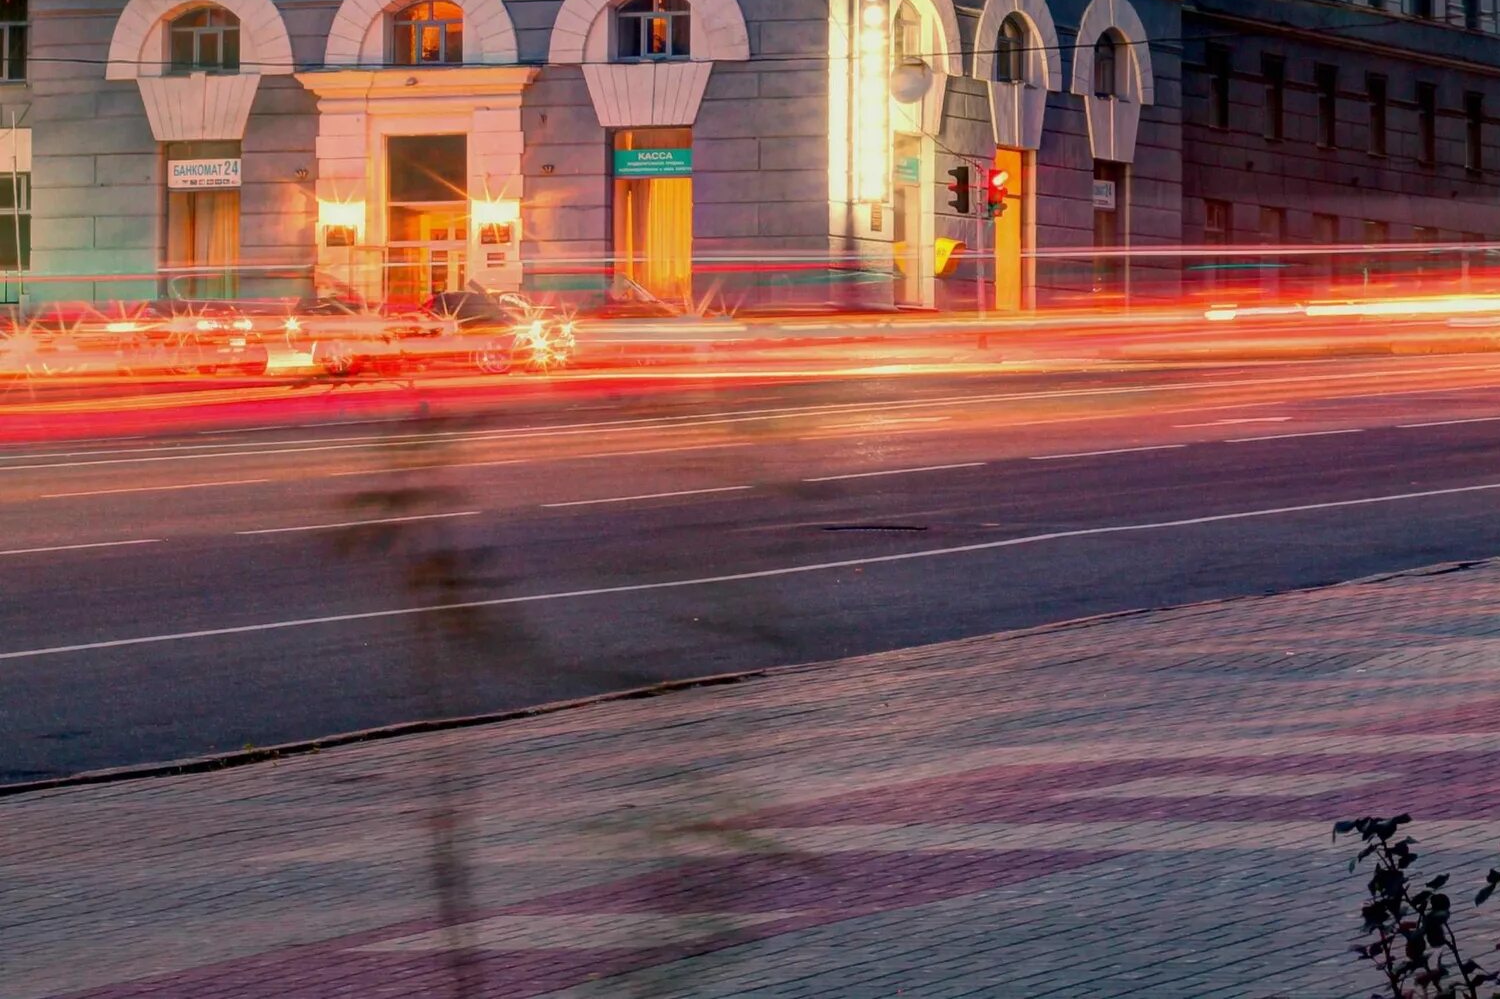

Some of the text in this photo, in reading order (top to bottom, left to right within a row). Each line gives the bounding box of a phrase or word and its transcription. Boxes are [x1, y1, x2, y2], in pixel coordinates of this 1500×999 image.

[638, 152, 673, 161] КАССА
[173, 160, 238, 177] БАНКОМАТ 24
